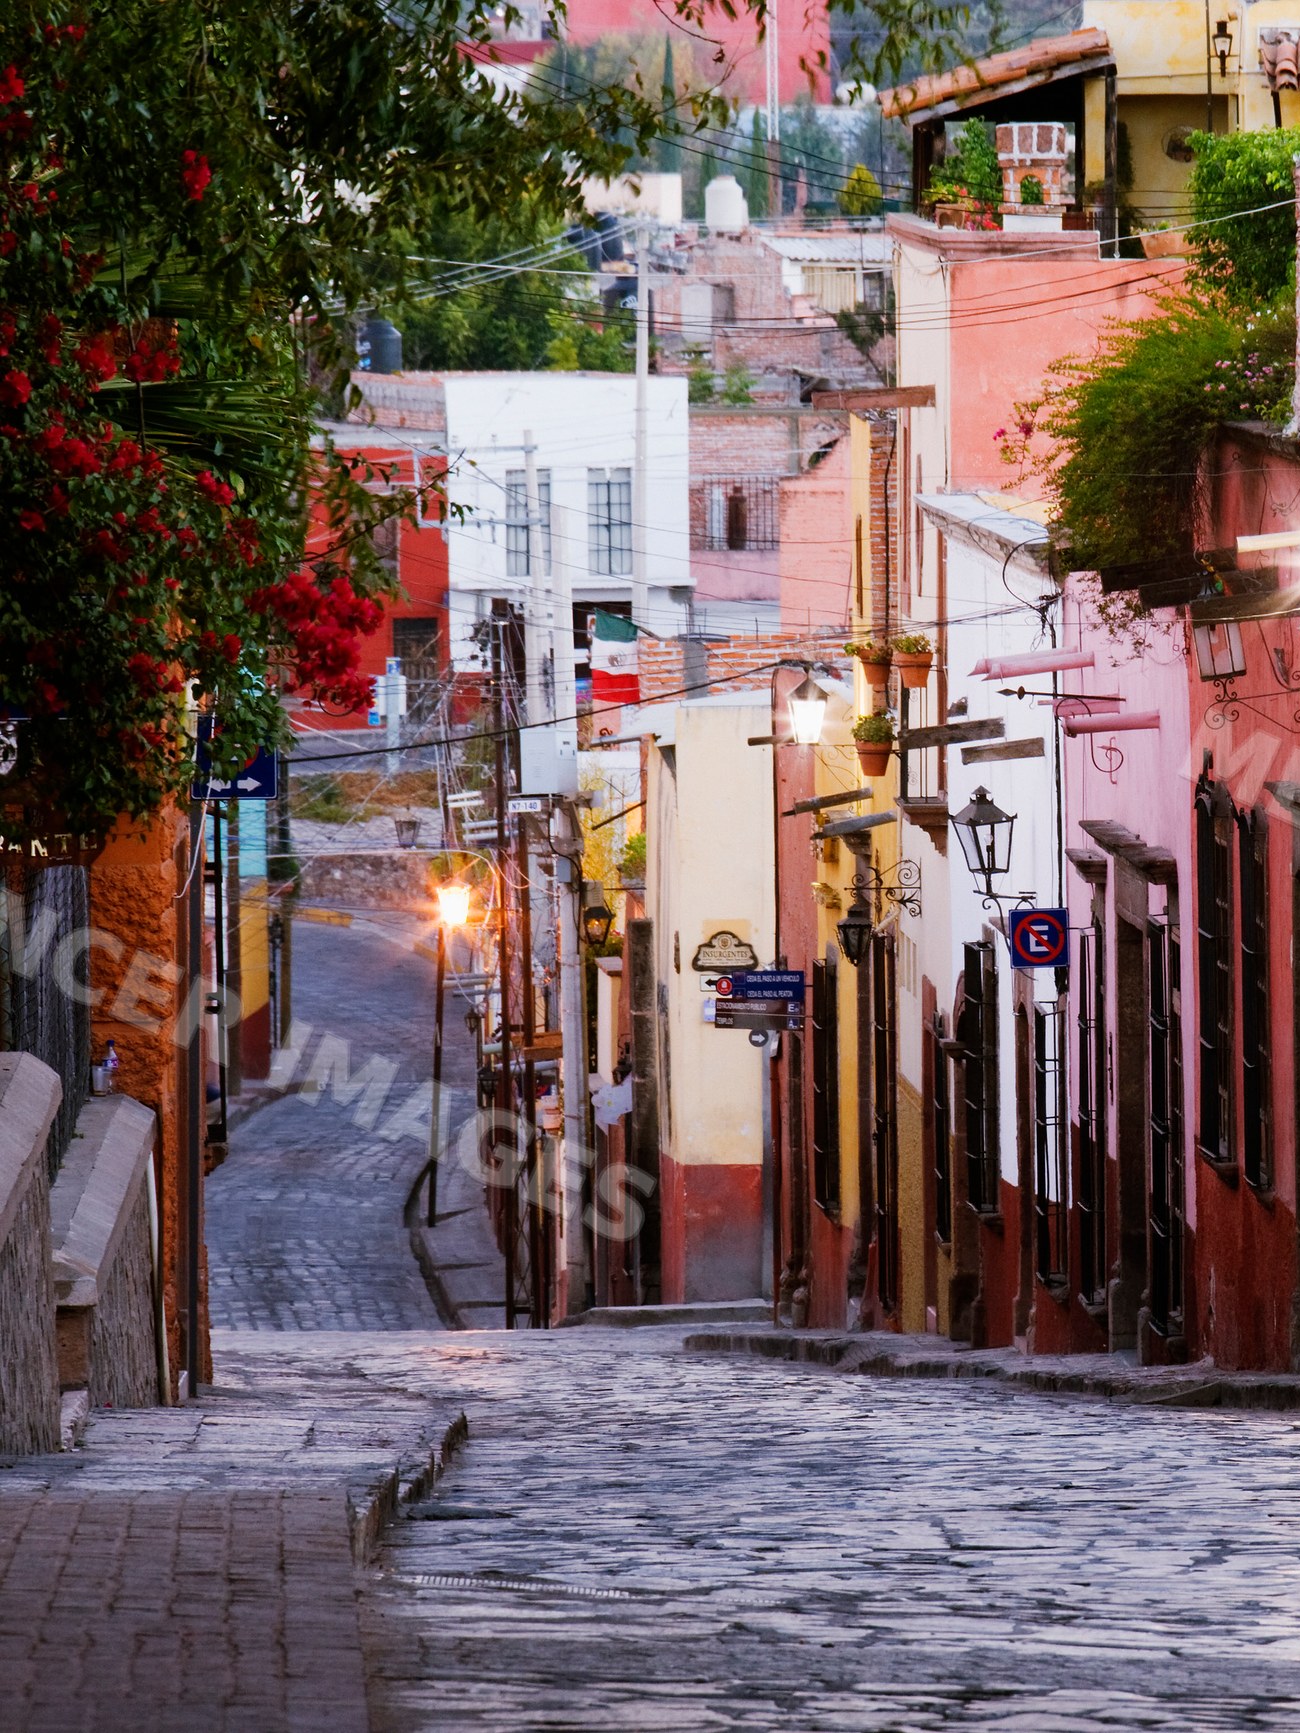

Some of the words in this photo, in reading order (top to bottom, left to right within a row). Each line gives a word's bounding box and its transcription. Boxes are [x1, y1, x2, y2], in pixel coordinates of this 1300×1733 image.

[1029, 925, 1050, 952] E
[702, 950, 748, 958] INSURGENTES
[747, 990, 757, 998] CEDA
[763, 990, 773, 998] PASO
